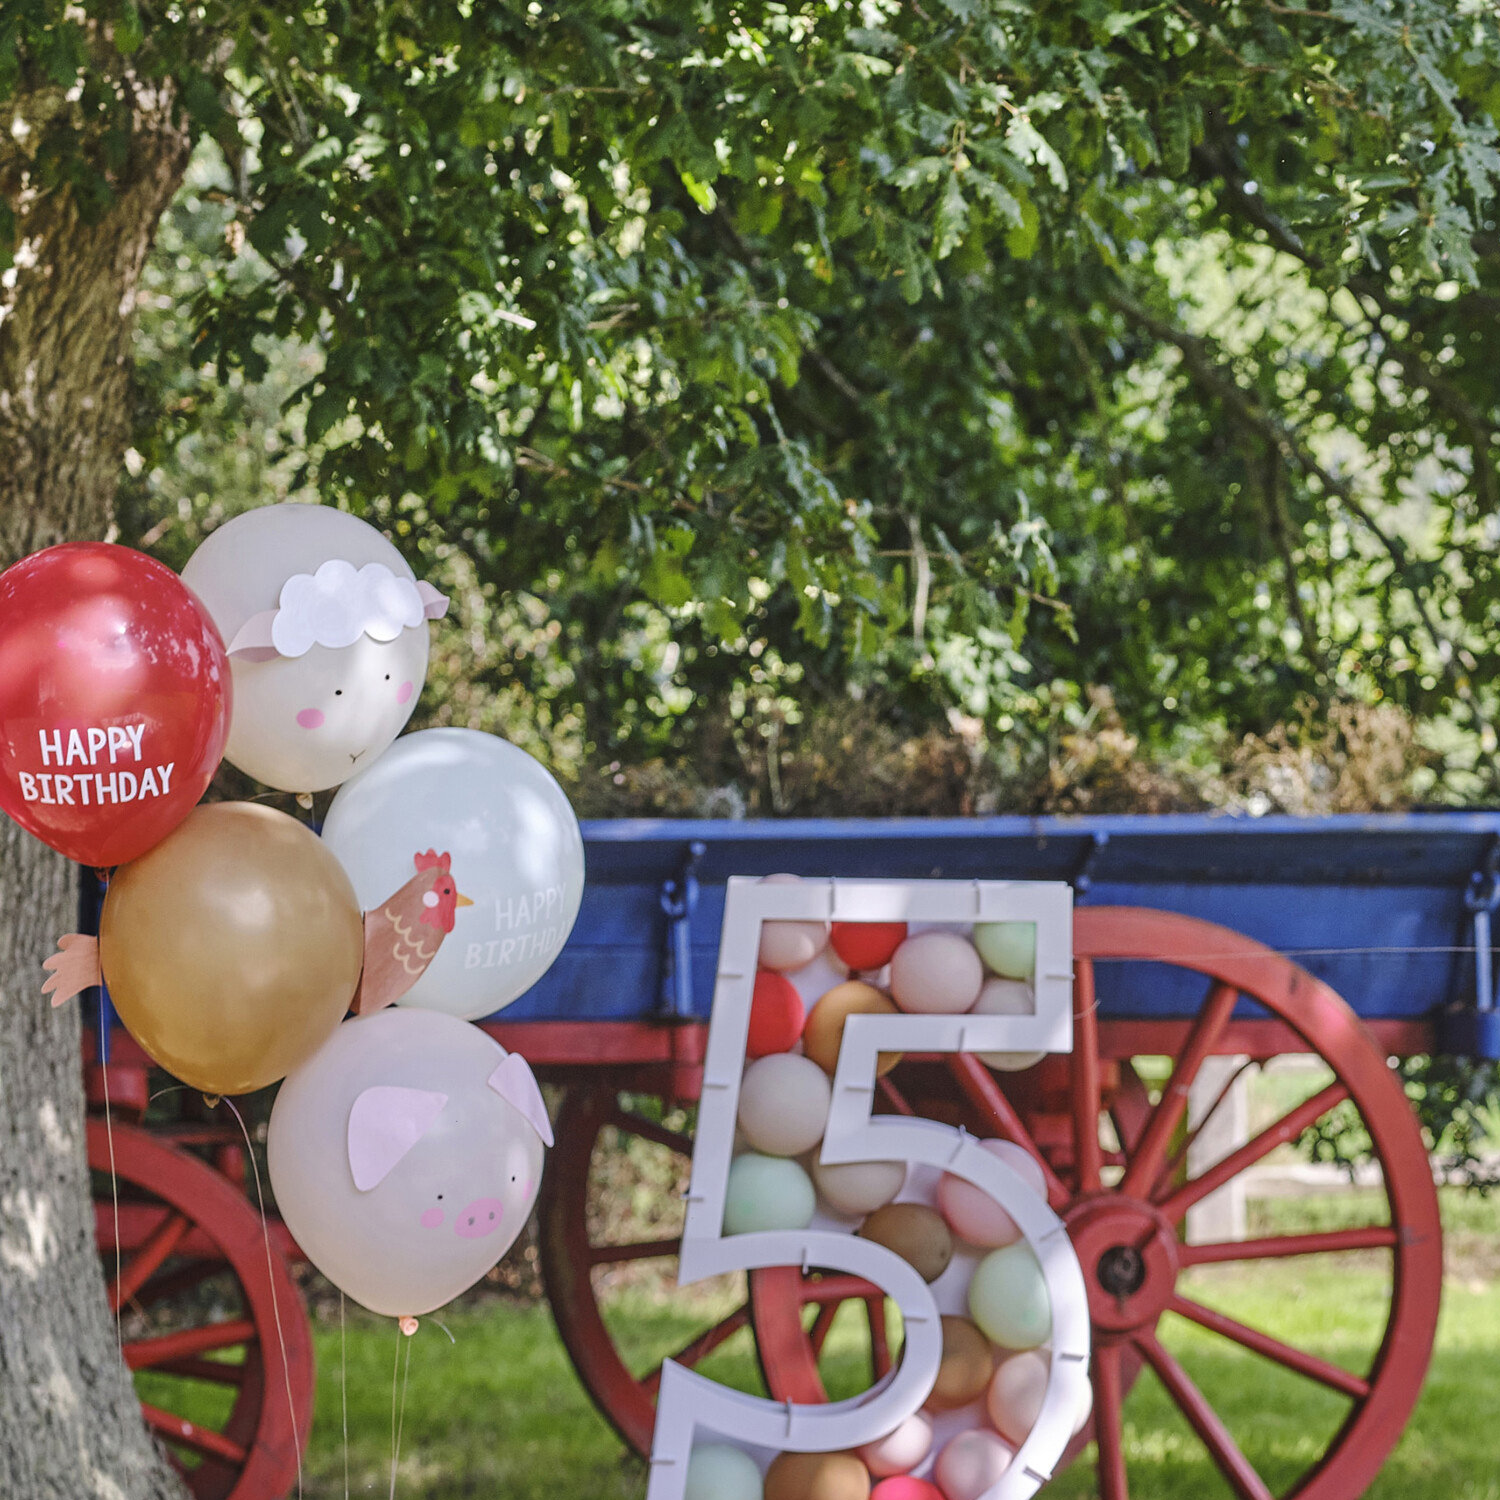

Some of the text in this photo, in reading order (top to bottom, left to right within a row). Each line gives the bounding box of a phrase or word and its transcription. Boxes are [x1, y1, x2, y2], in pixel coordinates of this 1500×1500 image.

[39, 723, 146, 767] HAPPY
[18, 762, 175, 806] BIRTHDAY
[494, 881, 567, 932] HAPPY
